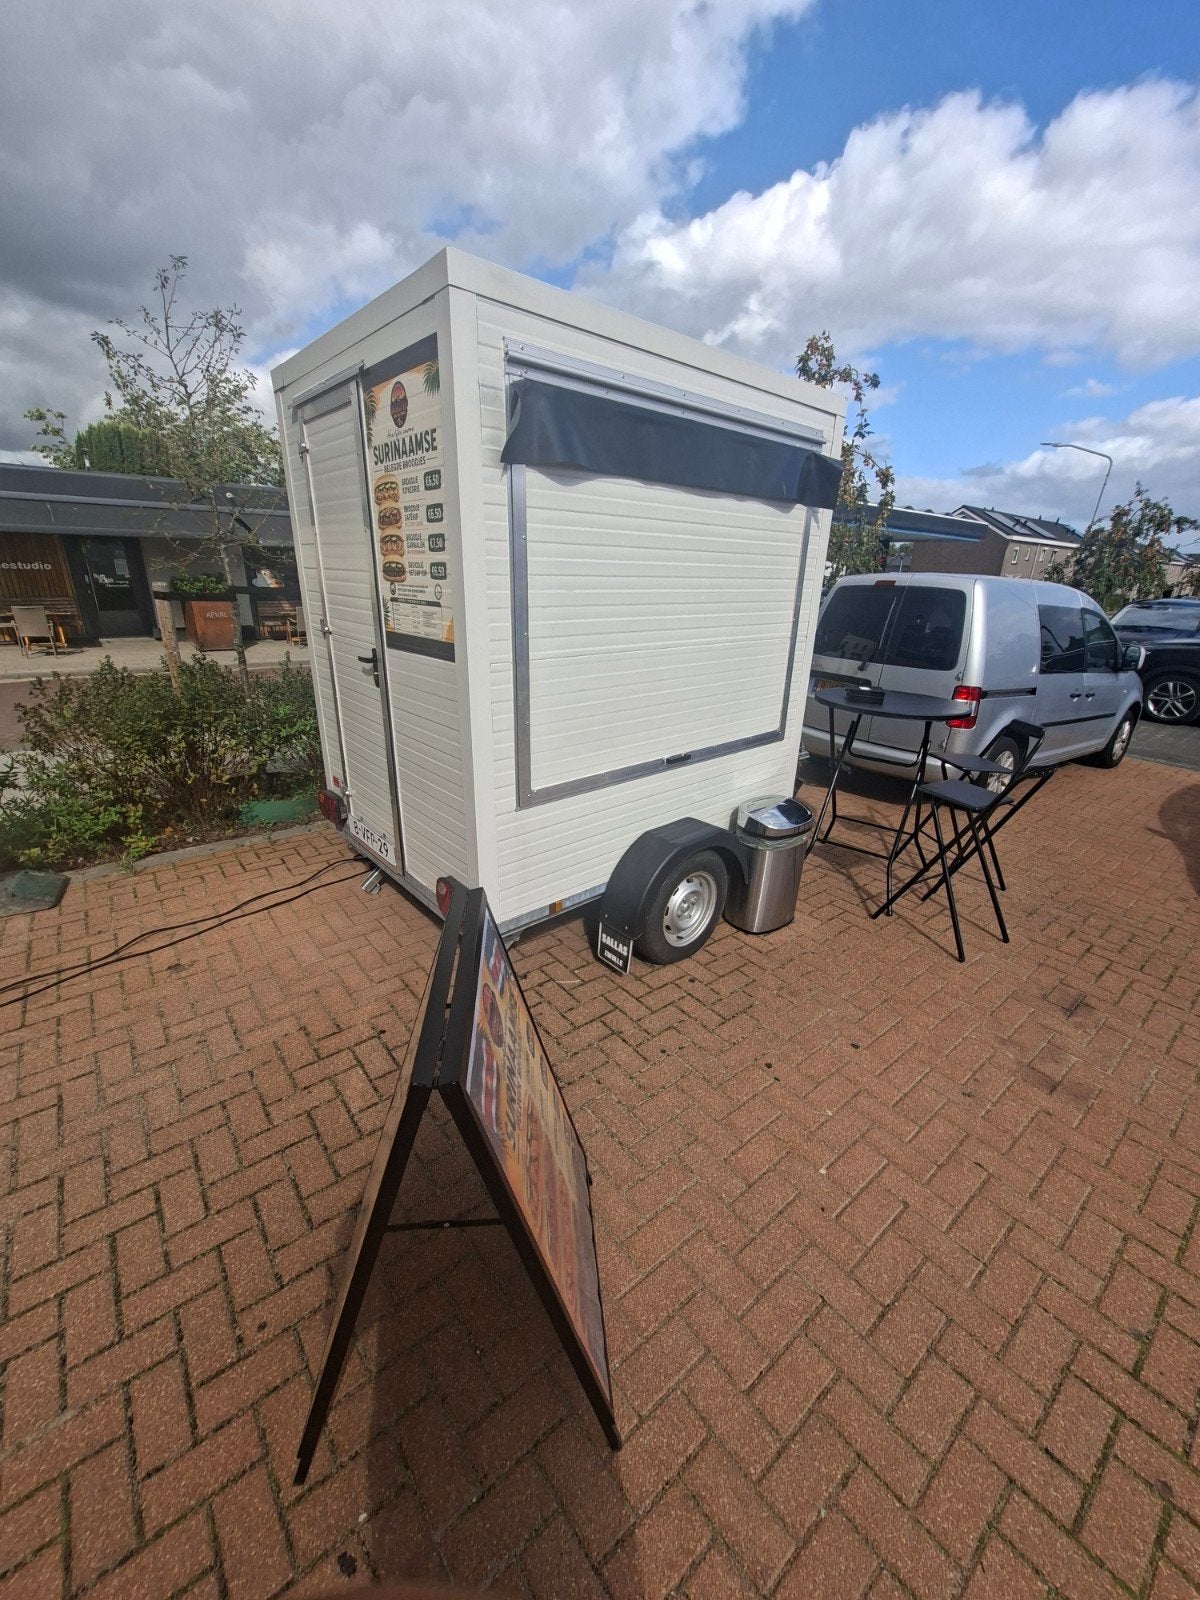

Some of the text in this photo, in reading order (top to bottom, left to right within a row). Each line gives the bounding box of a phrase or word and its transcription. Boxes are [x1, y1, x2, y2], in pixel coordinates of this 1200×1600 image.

[373, 428, 438, 466] SURINAAMSE
[384, 456, 426, 473] BELEGDE BROODJES
[0, 561, 52, 570] estudio
[602, 933, 628, 956] SALLAS
